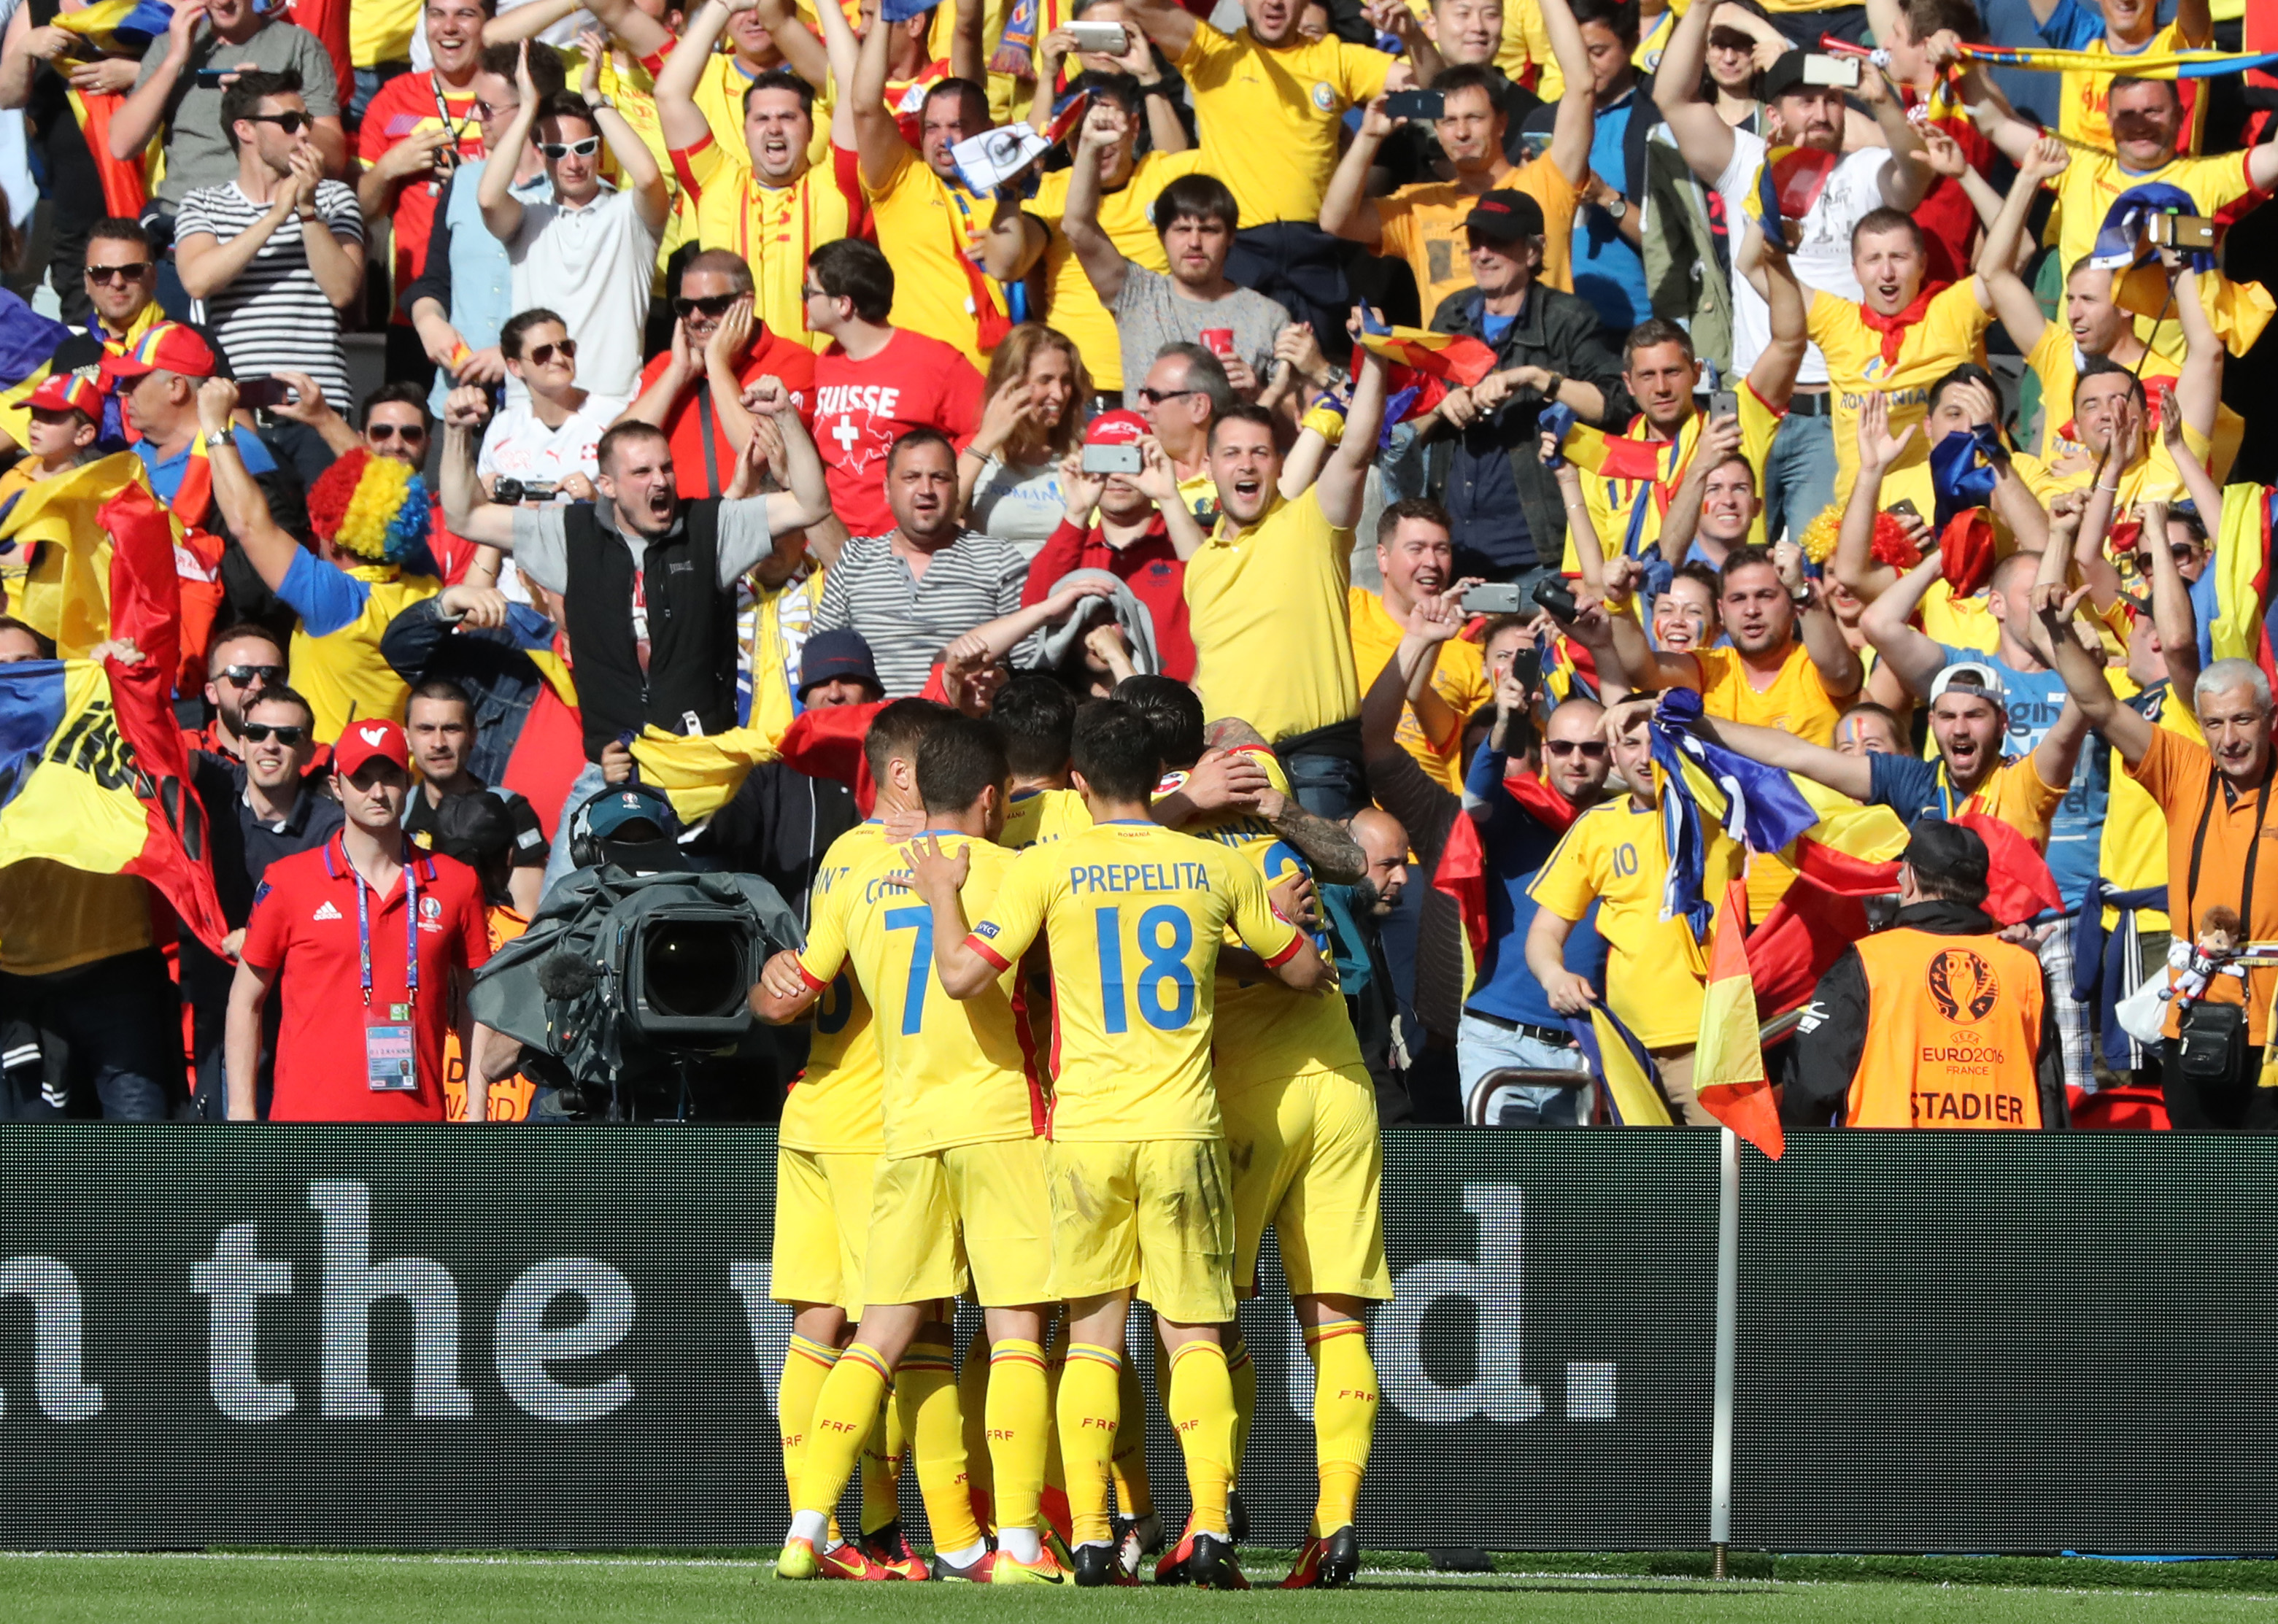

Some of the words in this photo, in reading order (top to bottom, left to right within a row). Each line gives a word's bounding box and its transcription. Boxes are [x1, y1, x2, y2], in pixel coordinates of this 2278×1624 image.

[814, 384, 900, 419] SUISSE
[1840, 387, 1928, 410] RONIA
[1613, 842, 1638, 878] 10
[1070, 862, 1211, 894] PREPELITA
[313, 912, 343, 921] adidas
[884, 905, 934, 1036] 7
[1095, 904, 1195, 1034] 18
[1951, 1033, 1980, 1045] UEFA
[1923, 1047, 2005, 1064] EURO2016
[1946, 1066, 1990, 1075] FRANCE
[189, 1180, 636, 1422] the
[820, 1420, 857, 1434] FRF
[1081, 1418, 1117, 1431] FRF
[987, 1429, 1014, 1441] FRF
